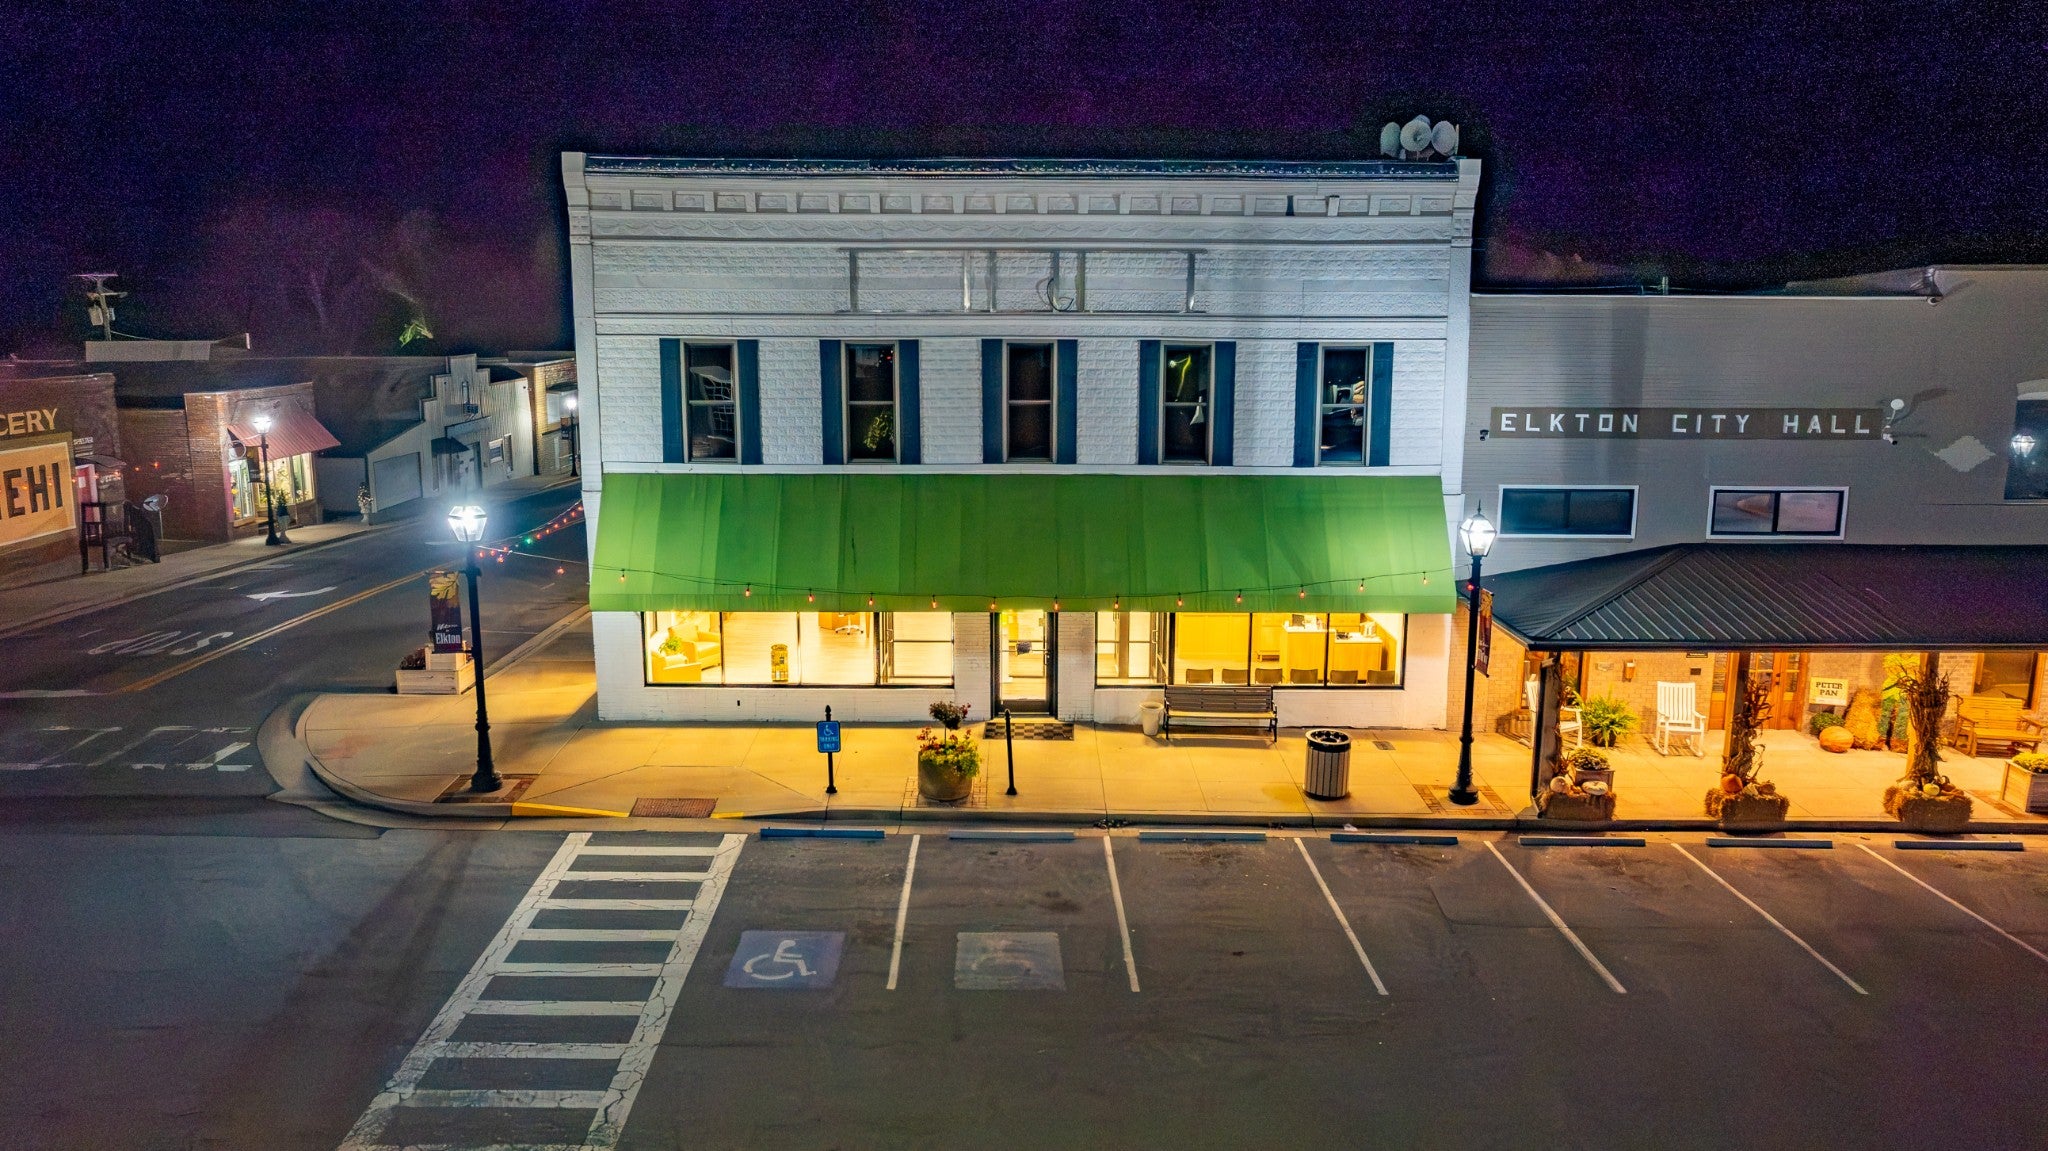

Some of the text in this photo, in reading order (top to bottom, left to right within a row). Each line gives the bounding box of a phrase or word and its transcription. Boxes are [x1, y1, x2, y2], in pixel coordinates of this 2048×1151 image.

[1500, 413, 1870, 434] ELKTON CITY HALL
[0, 462, 63, 520] EHI
[435, 632, 461, 644] Elkton
[1815, 681, 1843, 689] PETER
